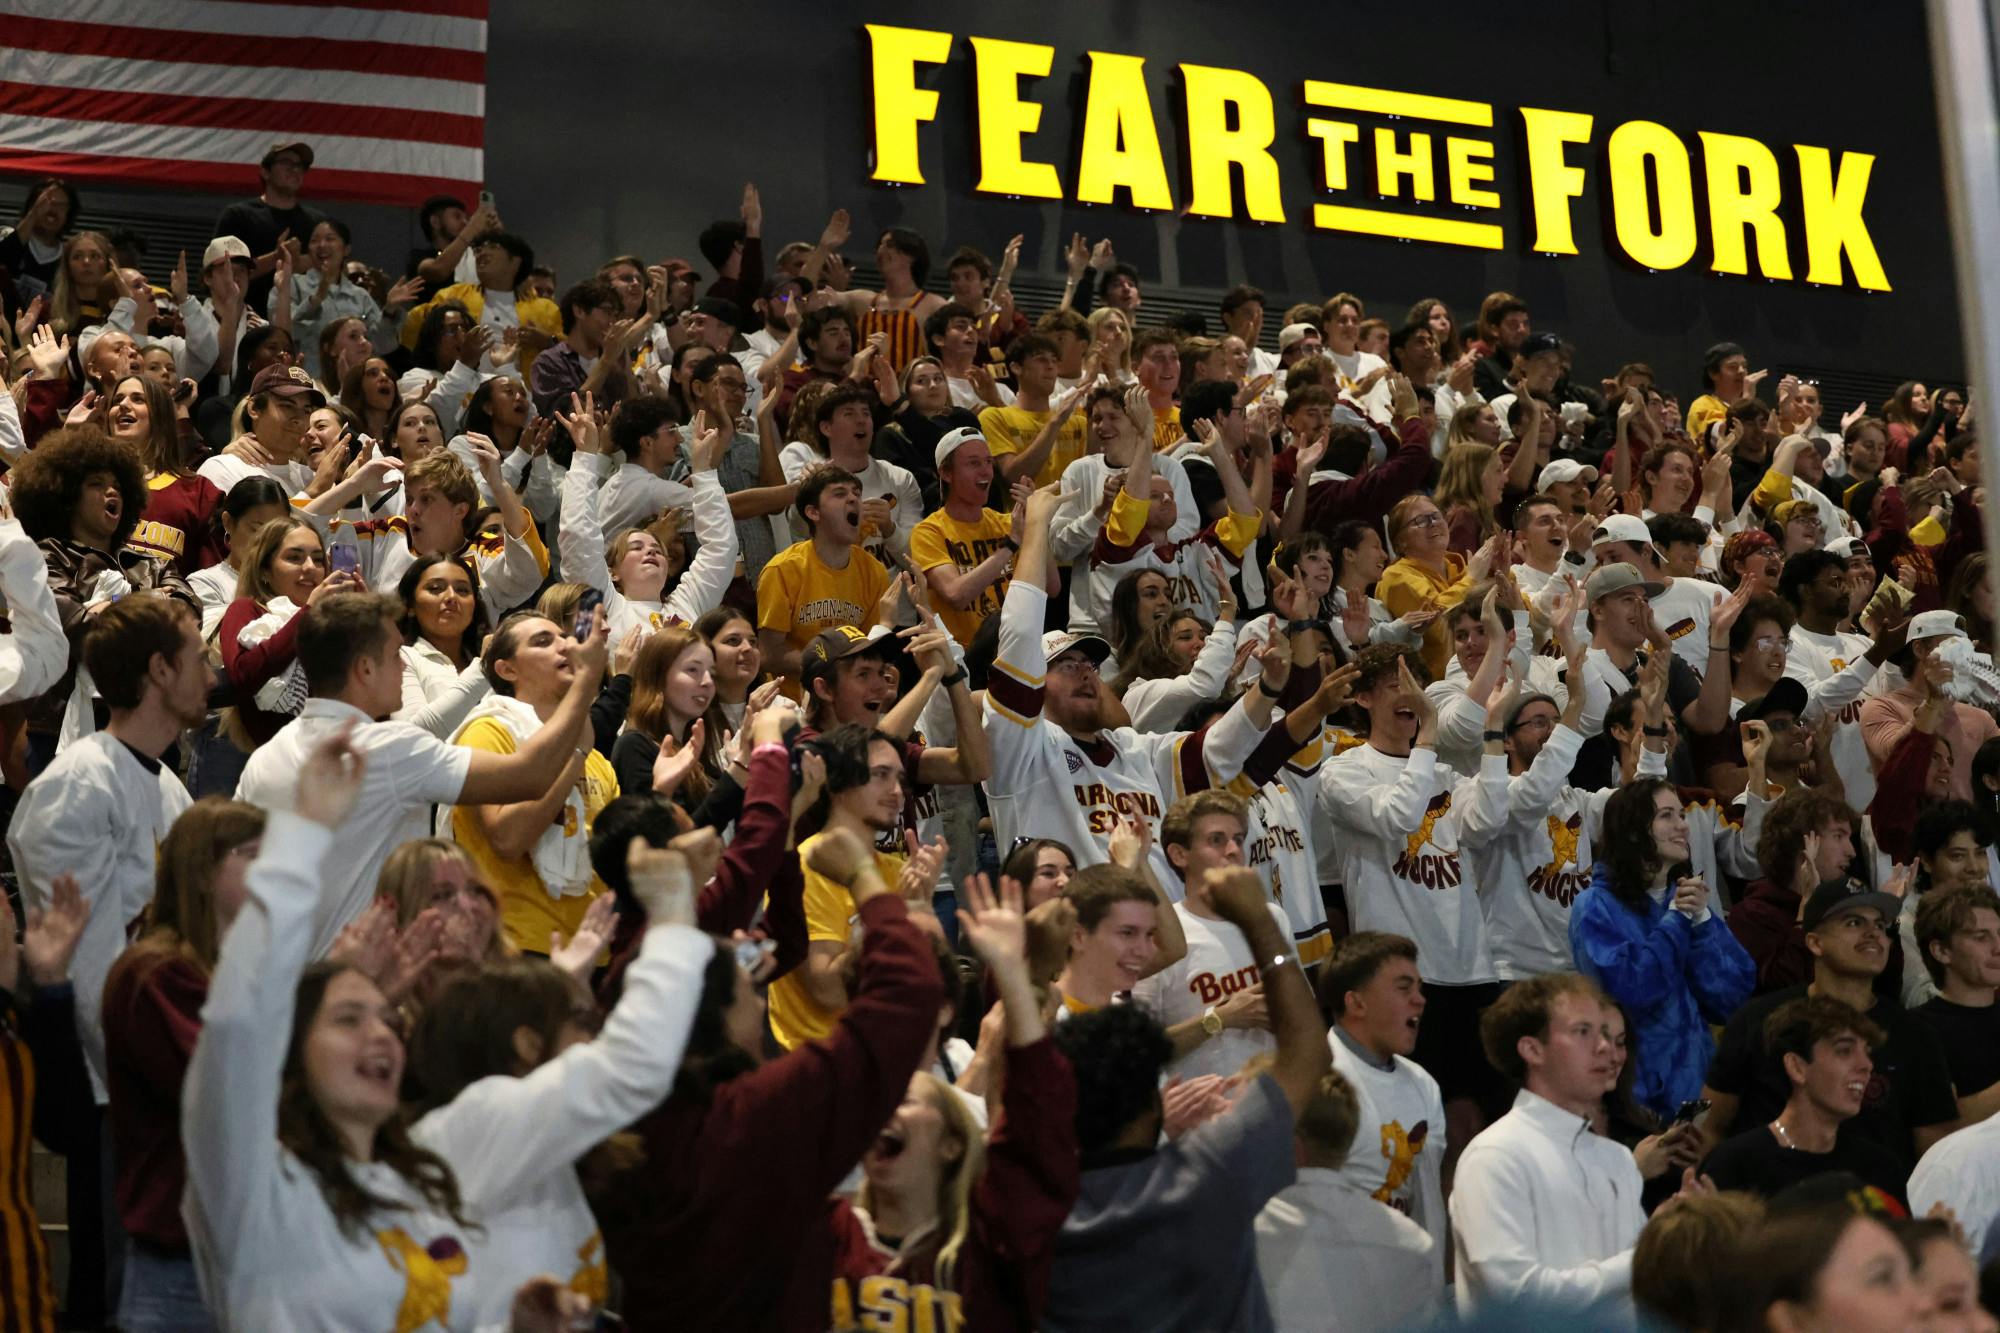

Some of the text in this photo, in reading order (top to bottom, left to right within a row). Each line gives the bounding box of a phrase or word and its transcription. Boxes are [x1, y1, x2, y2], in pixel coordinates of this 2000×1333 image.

[866, 25, 1892, 292] FEAR THE FORK
[798, 599, 841, 624] ARIZONA
